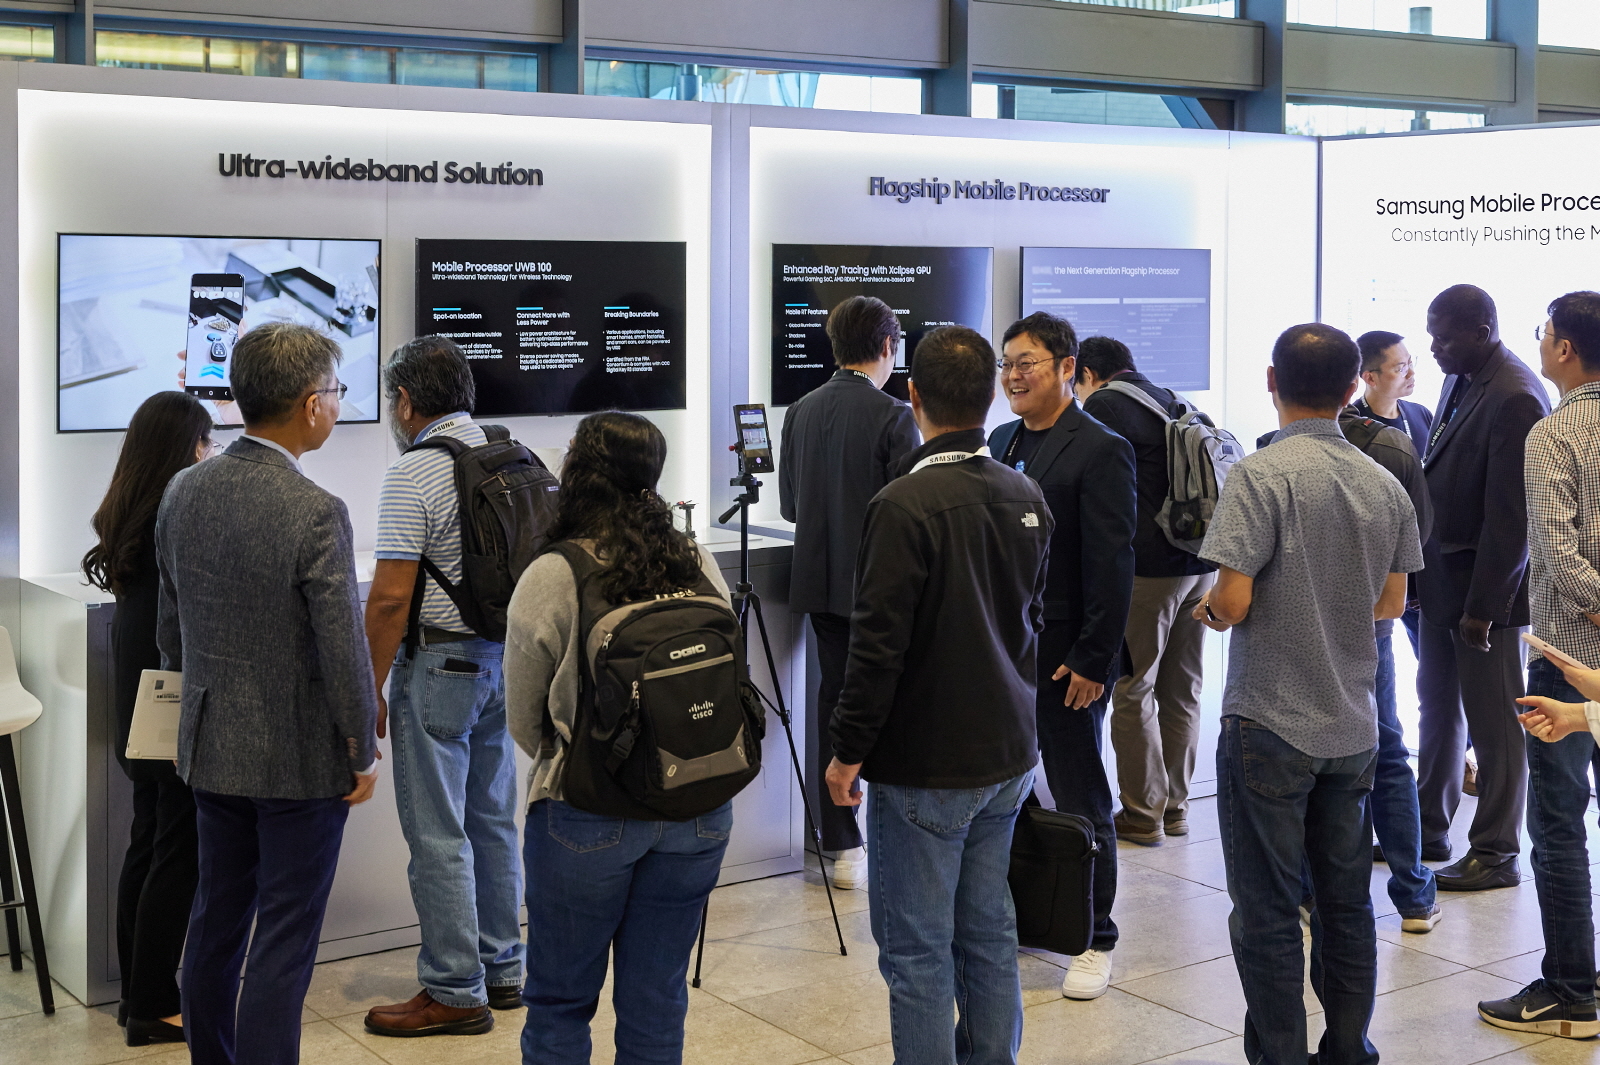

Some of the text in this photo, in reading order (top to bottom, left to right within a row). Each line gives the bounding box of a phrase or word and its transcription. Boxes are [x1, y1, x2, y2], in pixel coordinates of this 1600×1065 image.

[218, 152, 544, 186] Ultra-wideband Solution
[870, 176, 1110, 204] Flagship Mobile Processor
[1376, 198, 1464, 220] Samsung
[1470, 192, 1535, 212] Mobile
[1392, 226, 1479, 246] Constantly
[1484, 225, 1550, 246] Pushing
[1556, 225, 1586, 240] the
[432, 260, 552, 272] Mobile Processor UWB 100
[783, 265, 931, 276] Enhanced Ray Tracing with Xclipse GPU
[1054, 266, 1066, 274] the
[1084, 266, 1120, 275] Generation
[1122, 267, 1147, 277] Flagship
[433, 313, 457, 321] Spot-on
[604, 310, 628, 319] Breaking
[930, 454, 966, 464] SAMSUNG
[670, 644, 706, 660] OGIO
